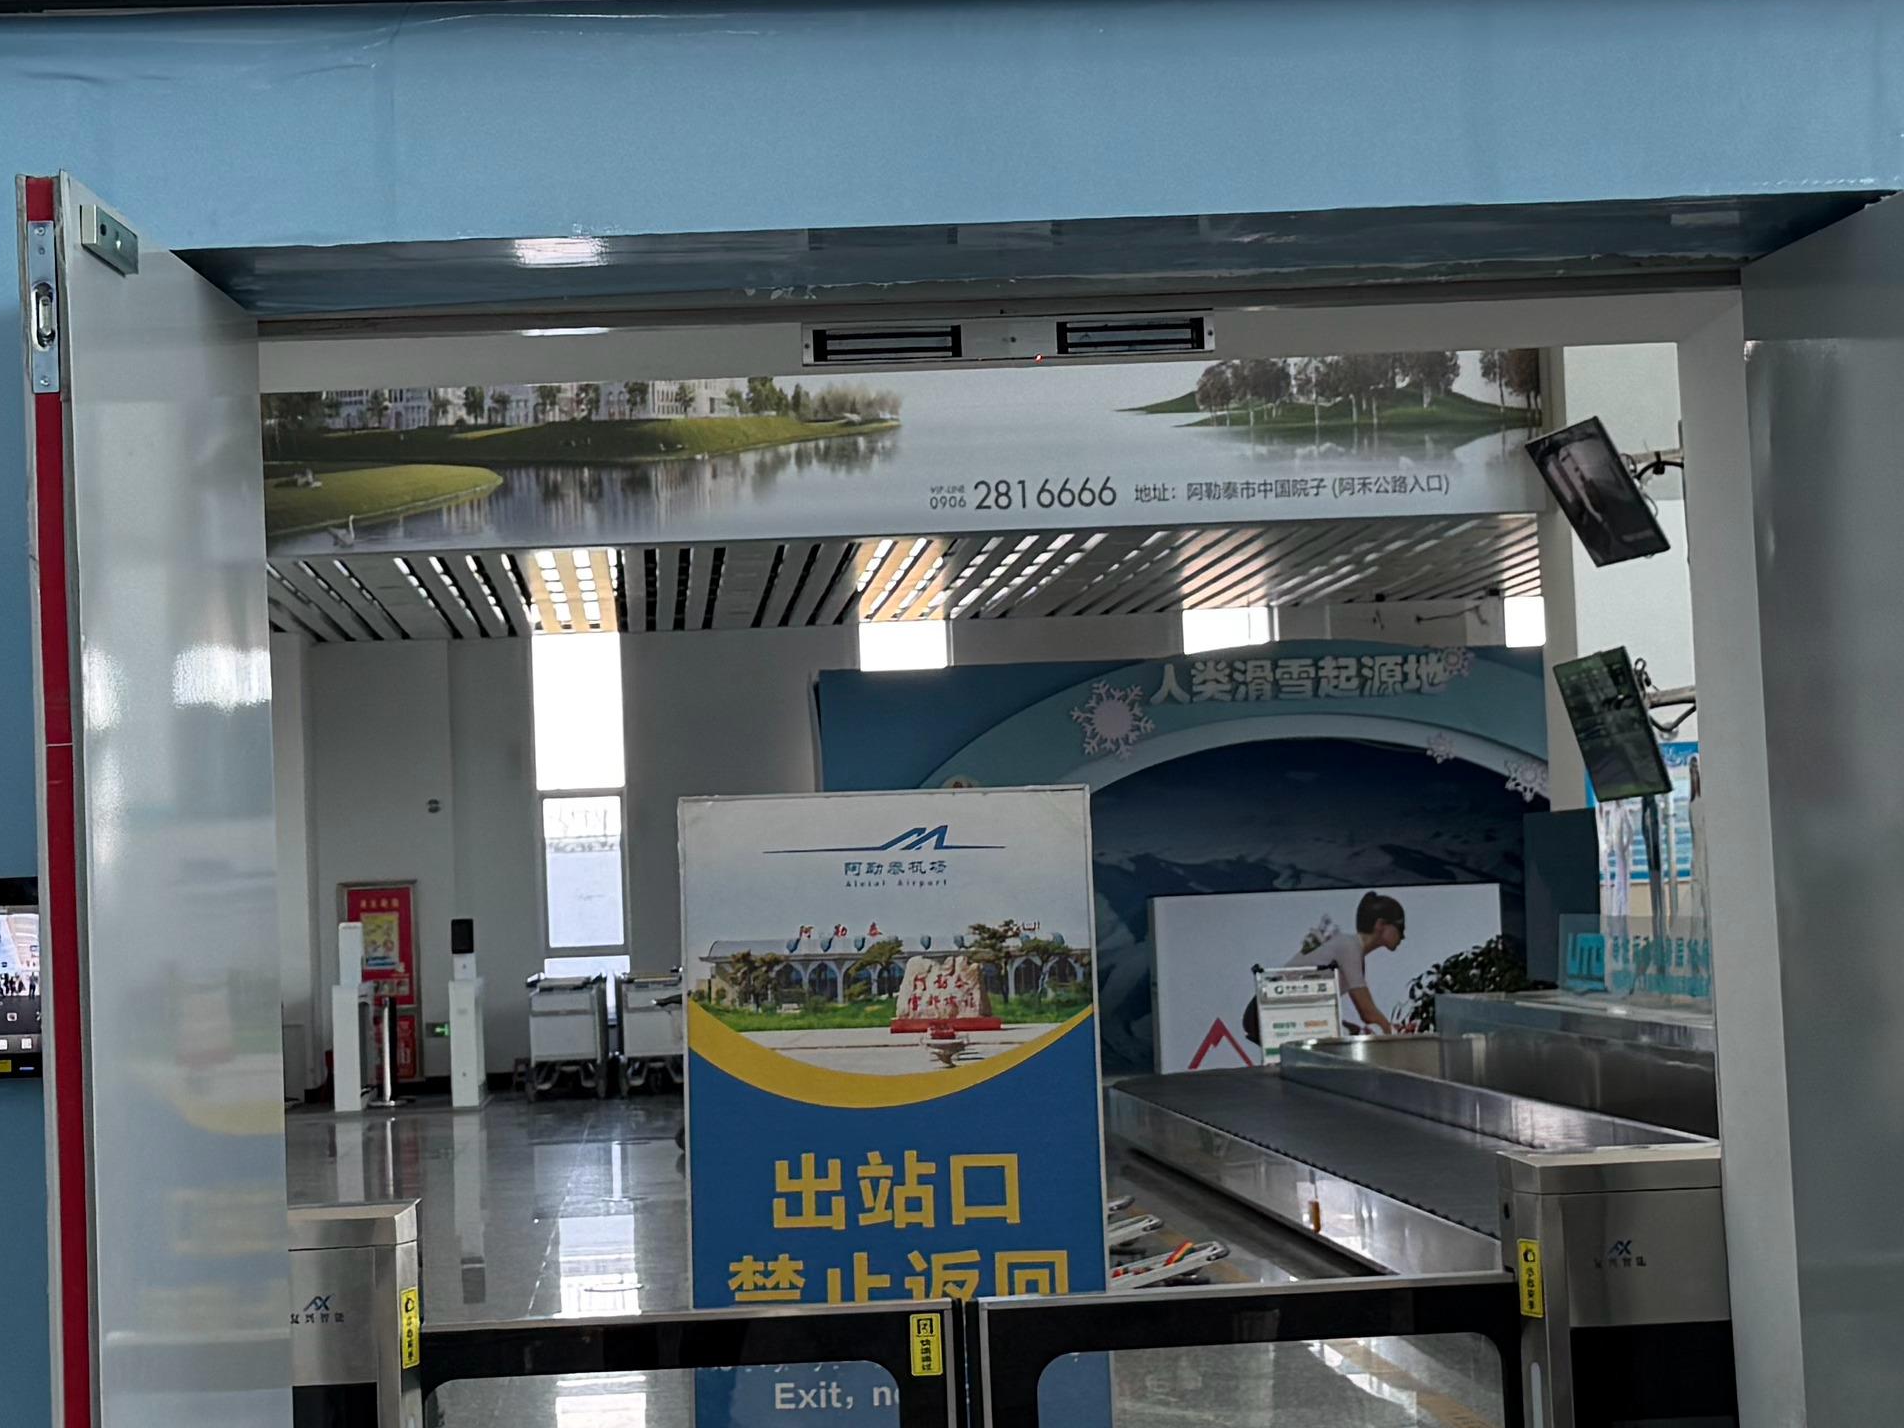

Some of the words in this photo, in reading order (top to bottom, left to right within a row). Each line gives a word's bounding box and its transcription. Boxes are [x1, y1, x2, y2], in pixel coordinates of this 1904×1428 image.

[930, 495, 967, 510] 0906
[974, 476, 1117, 510] 2816666
[1149, 654, 1448, 704] 人类滑雪起源地
[772, 1150, 1021, 1231] 出站口
